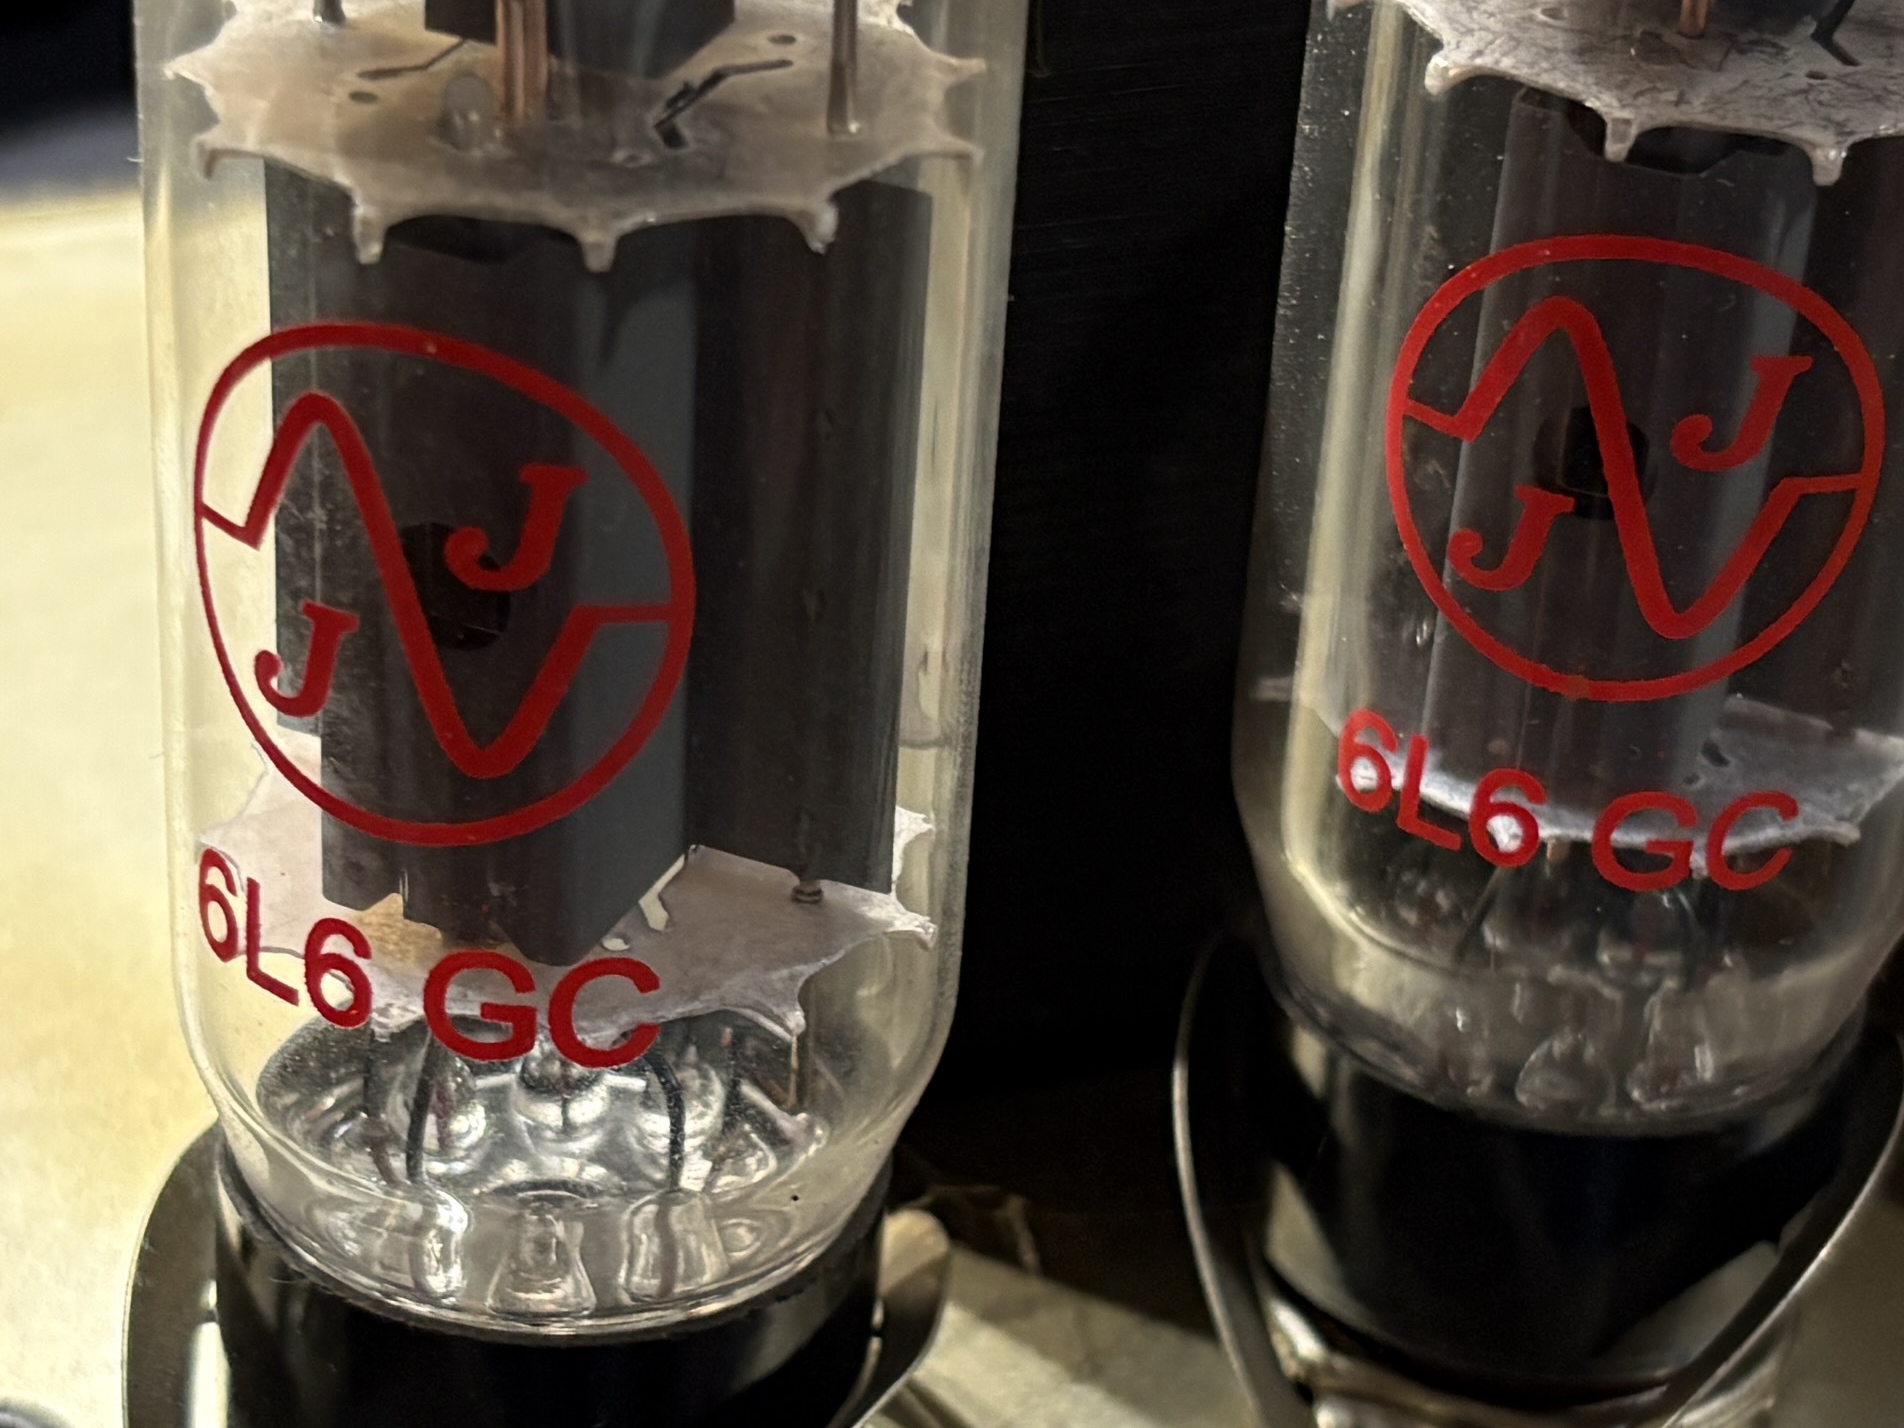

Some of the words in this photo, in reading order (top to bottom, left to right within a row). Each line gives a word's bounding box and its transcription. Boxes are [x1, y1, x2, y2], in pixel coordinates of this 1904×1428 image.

[1337, 708, 1547, 868] 6L6
[1592, 789, 1799, 892] GC
[199, 848, 373, 1028] 6L6
[424, 950, 661, 1069] GC
